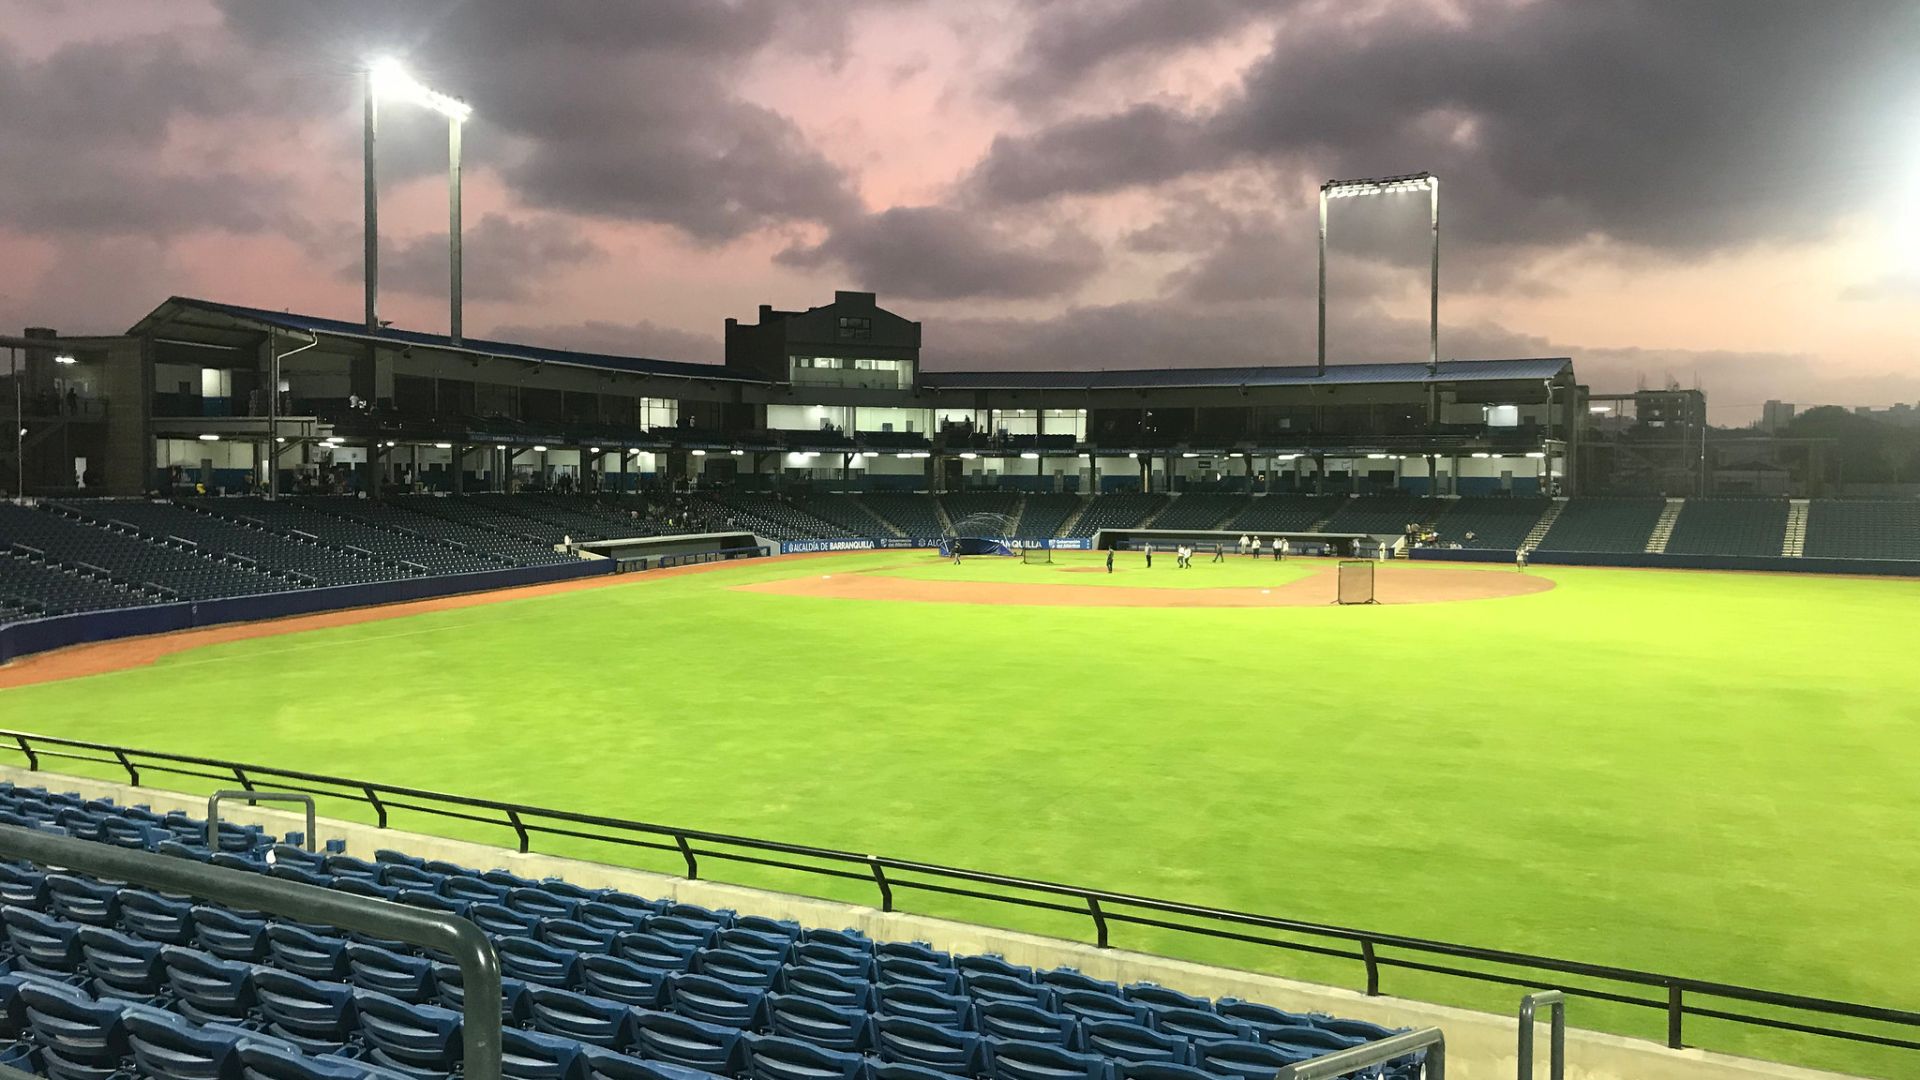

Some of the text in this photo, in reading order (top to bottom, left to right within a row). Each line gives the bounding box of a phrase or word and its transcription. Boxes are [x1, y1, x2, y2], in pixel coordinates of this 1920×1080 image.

[793, 541, 875, 552] ALCALDÍA DE BARRANQUILLA
